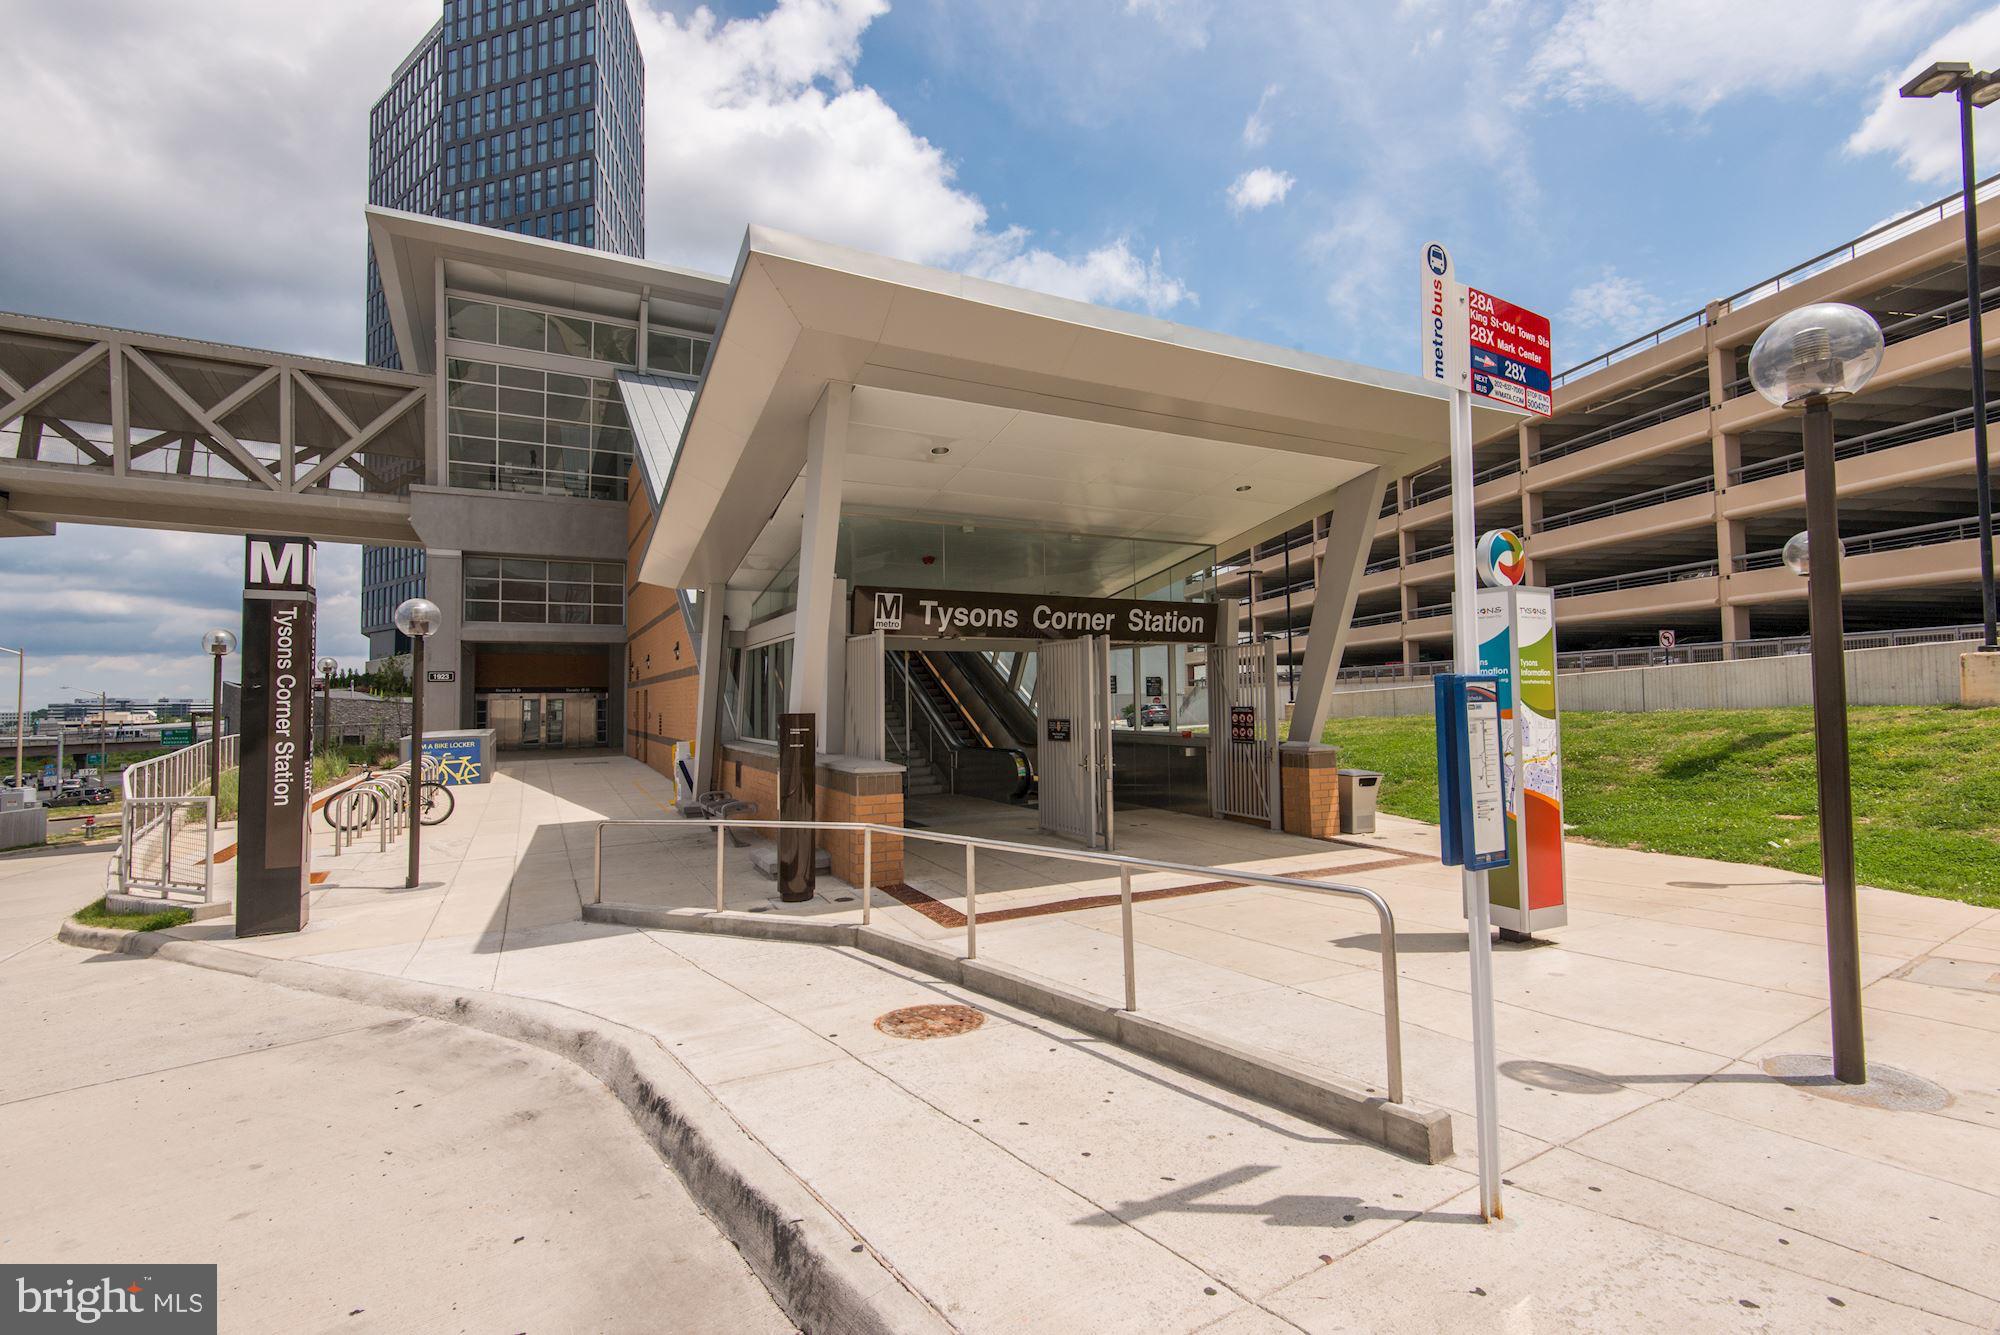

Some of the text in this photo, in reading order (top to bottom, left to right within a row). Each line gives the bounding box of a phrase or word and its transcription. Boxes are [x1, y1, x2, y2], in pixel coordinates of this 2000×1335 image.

[1470, 291, 1495, 315] 28A
[1432, 279, 1444, 379] metrobus
[1470, 309, 1550, 349] King St-Old Town Sta
[1470, 324, 1542, 364] 28X Mark Center
[1474, 373, 1488, 384] NEXT
[1504, 360, 1527, 383] 28X
[1475, 384, 1488, 394] BUS
[1494, 390, 1524, 405] WMATA.COM
[1527, 391, 1538, 400] STOP
[249, 540, 303, 585] M
[876, 595, 901, 620] M
[919, 600, 1205, 634] Tysons Corner Station
[875, 620, 900, 628] metro
[1520, 658, 1538, 668] Tysons
[1521, 668, 1551, 677] Information
[273, 606, 298, 806] Tysons Corner Station
[449, 741, 475, 749] LOCKER
